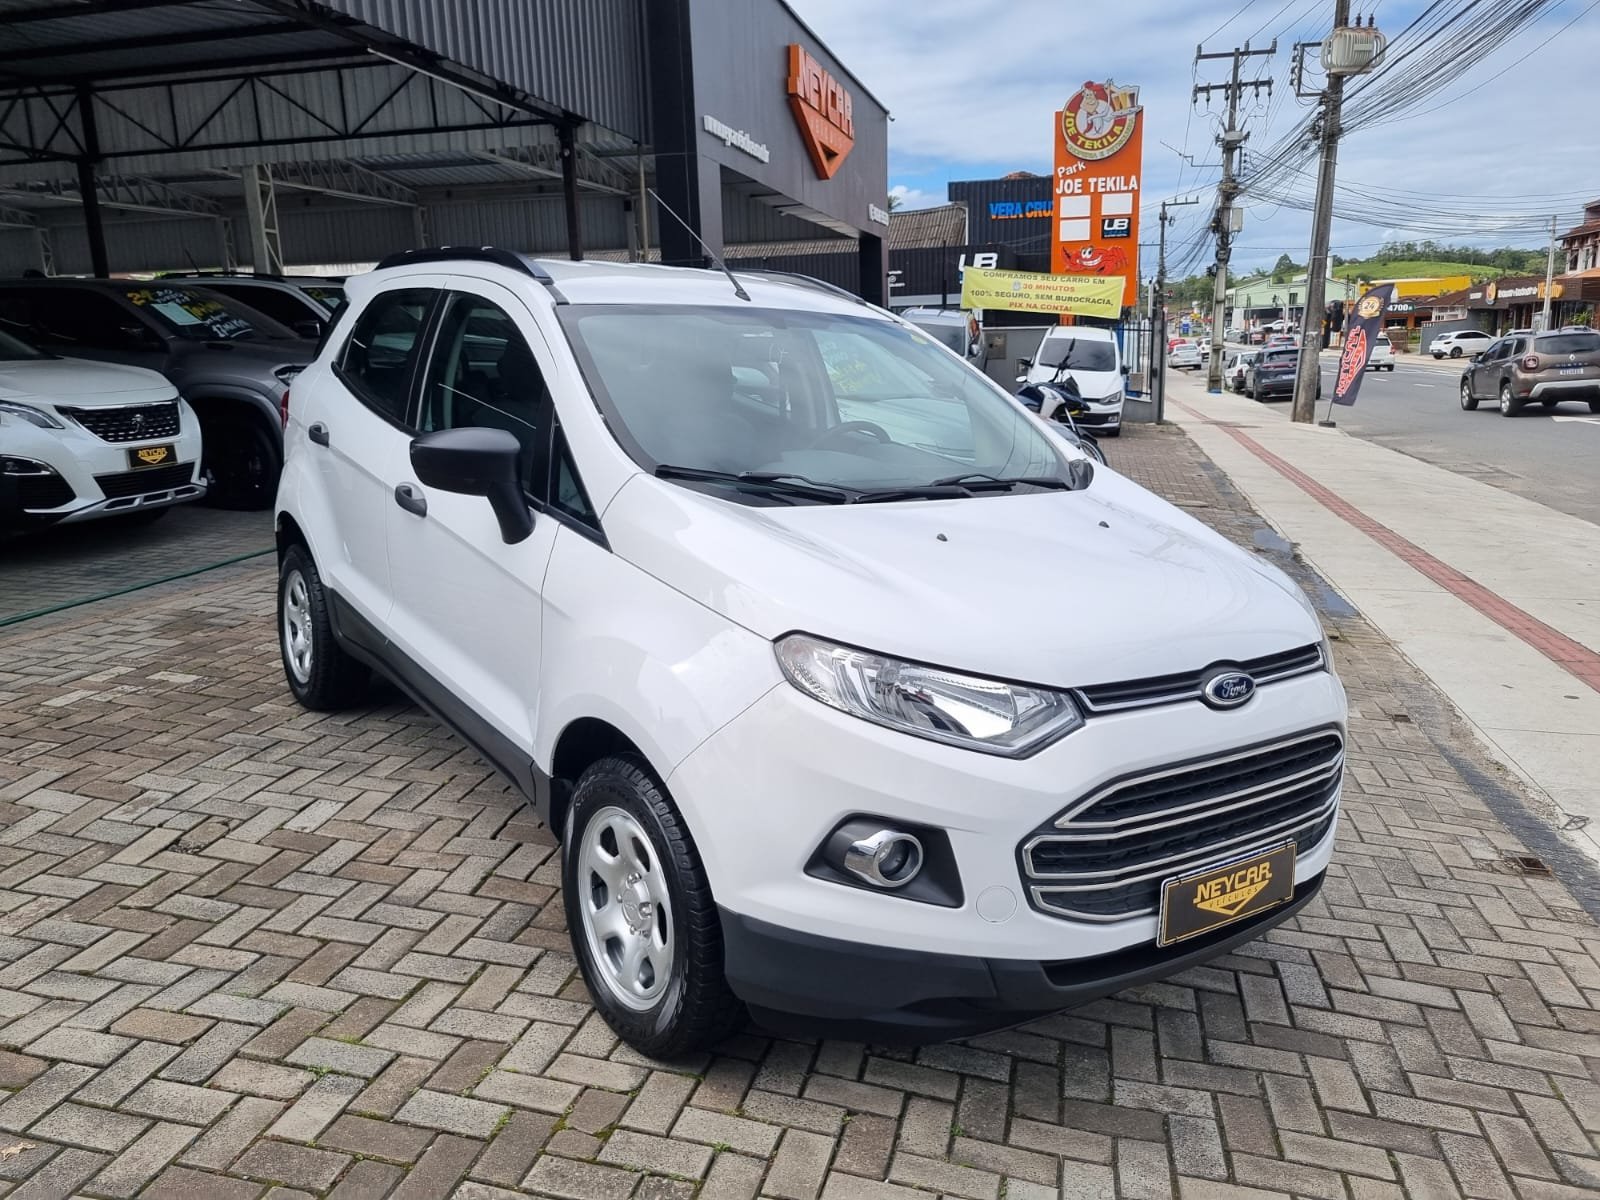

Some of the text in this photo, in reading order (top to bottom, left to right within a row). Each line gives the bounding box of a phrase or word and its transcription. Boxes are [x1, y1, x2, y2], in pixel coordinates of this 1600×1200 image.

[797, 44, 855, 140] NEYCAR
[1066, 111, 1078, 137] JOE
[1077, 125, 1123, 149] TEKILA
[1057, 160, 1086, 178] Park
[1056, 175, 1138, 194] JOE TEKILA
[989, 201, 1053, 219] VERA CRU
[983, 271, 1038, 281] COMPRAMOS
[1060, 276, 1090, 284] CARRO
[1023, 282, 1075, 293] 30 MINUTOS
[970, 289, 992, 297] 100%
[994, 291, 1032, 300] SEGURO,
[1055, 295, 1114, 306] BUROCRACIA,
[1222, 678, 1248, 698] Ford
[1193, 861, 1272, 904] NEYCAR
